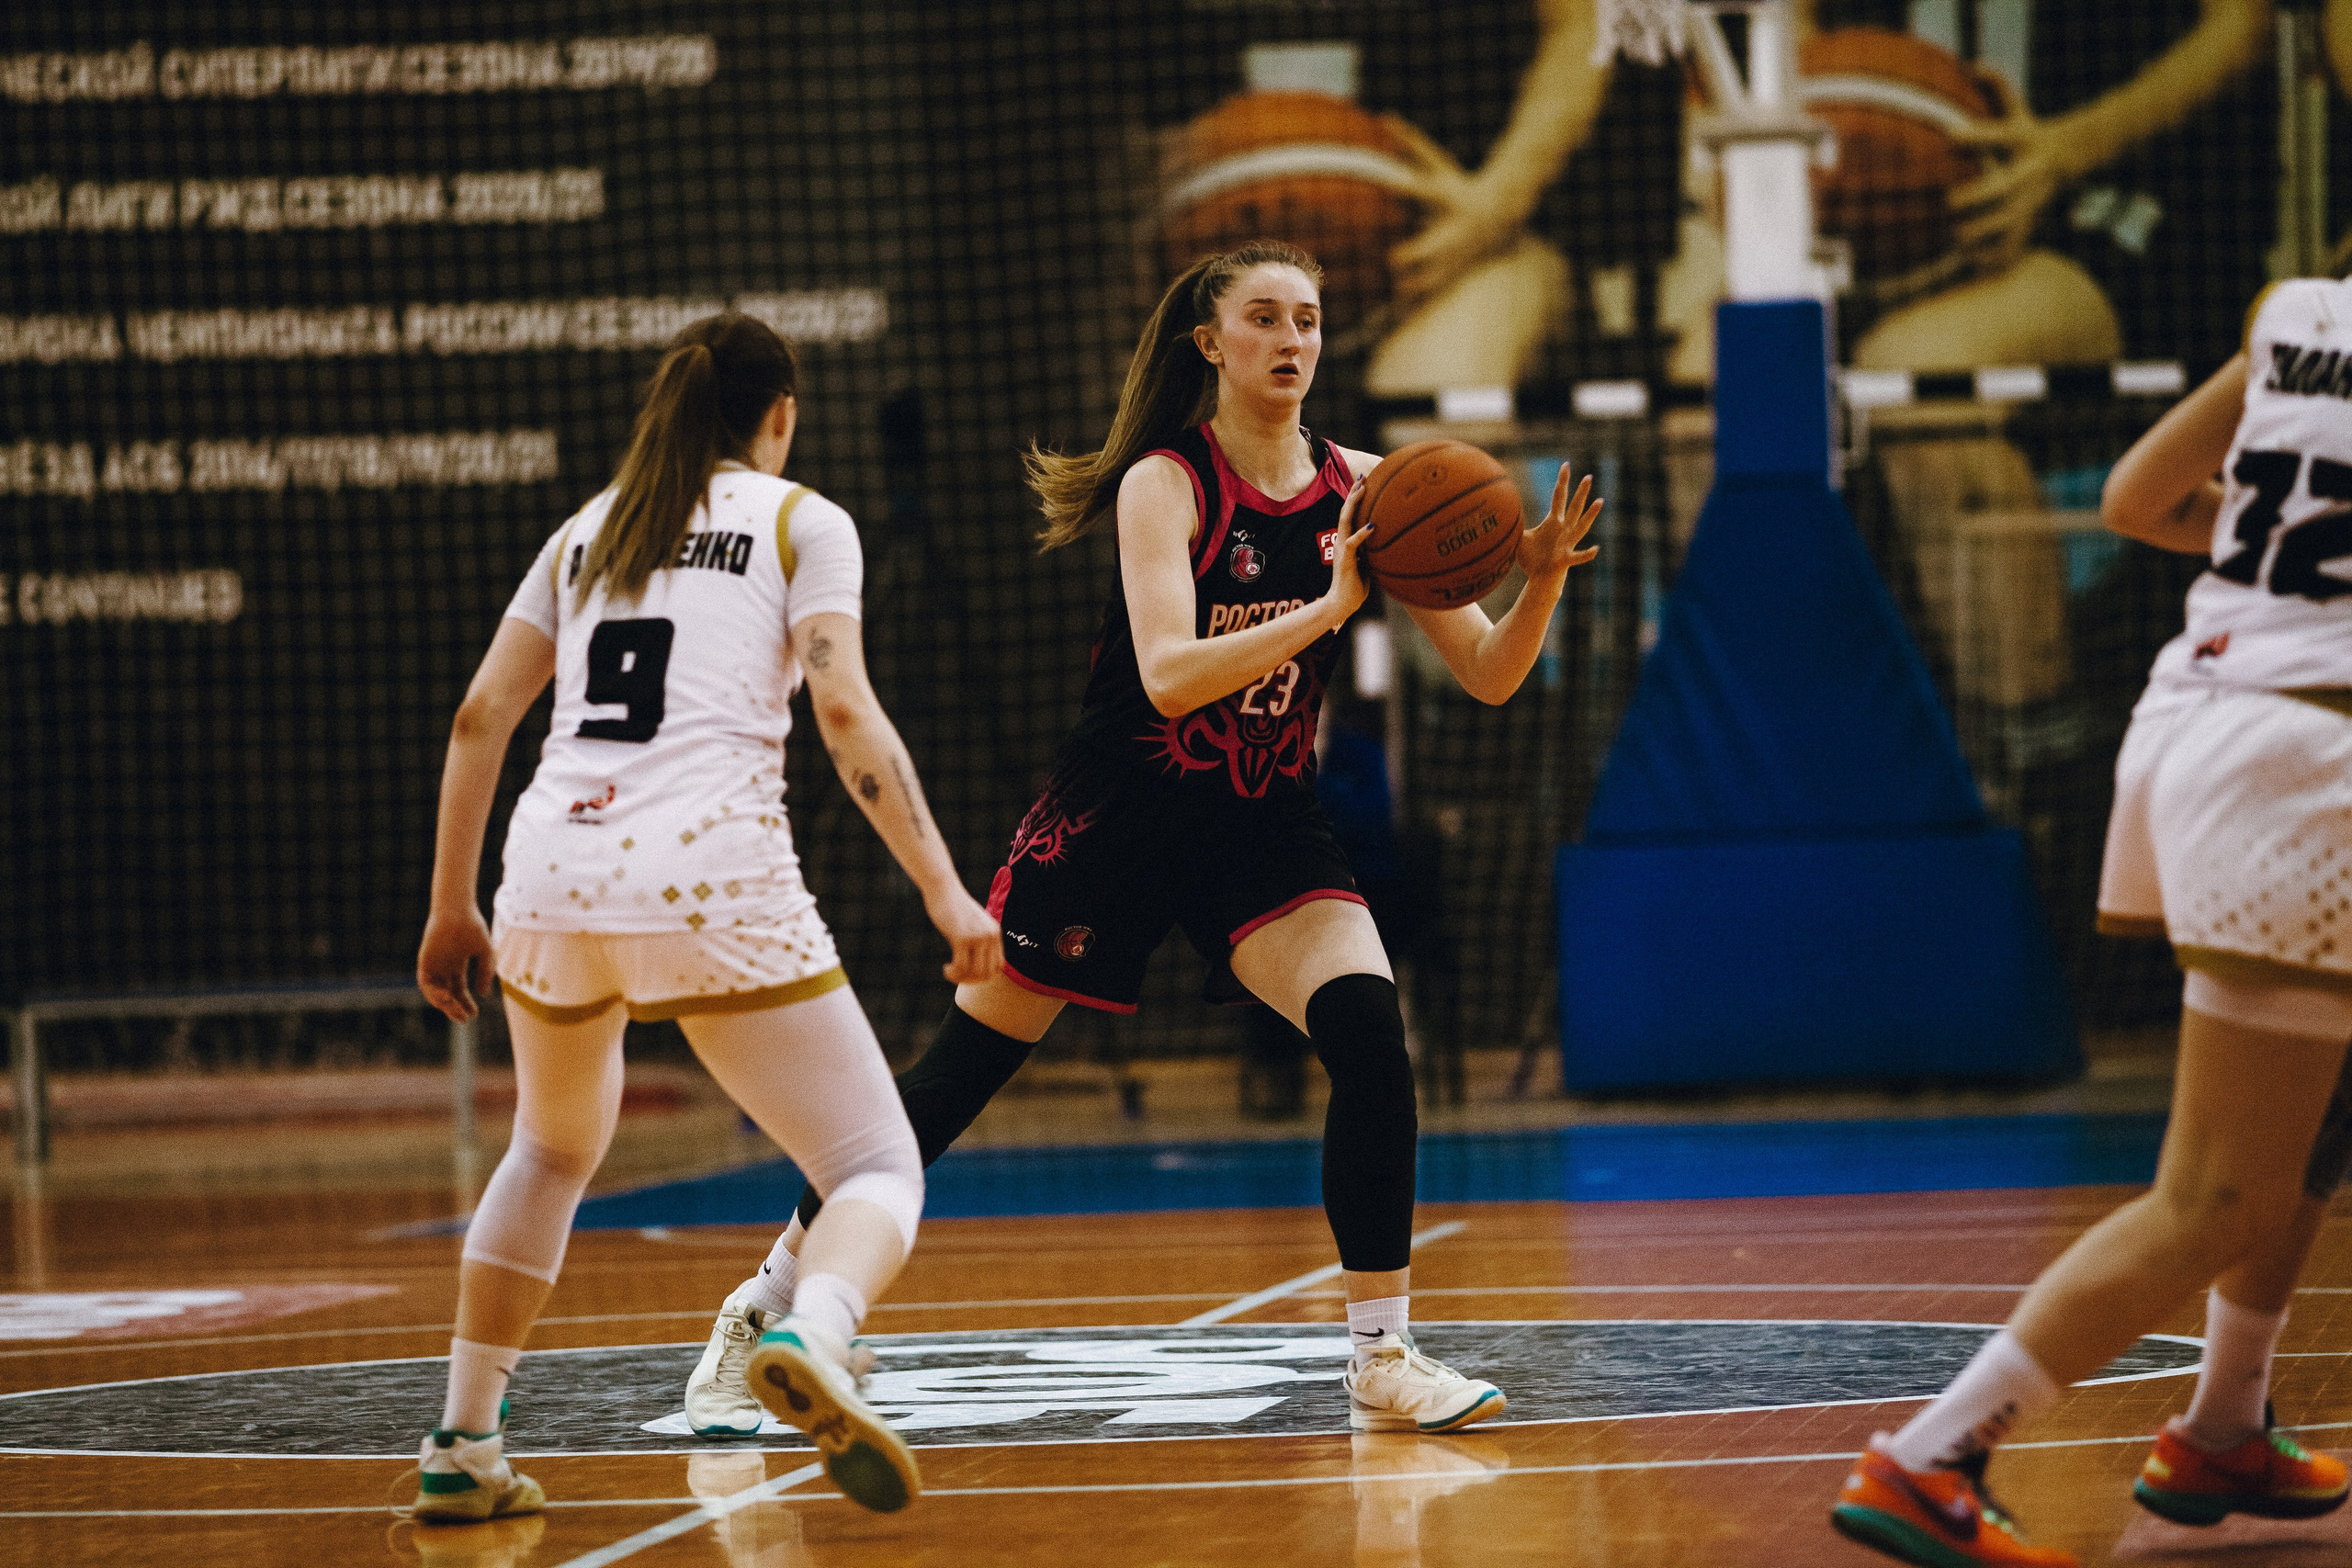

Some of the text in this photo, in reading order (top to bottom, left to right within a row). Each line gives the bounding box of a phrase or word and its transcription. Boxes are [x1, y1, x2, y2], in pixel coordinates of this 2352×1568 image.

[401, 42, 560, 95] СЕЗОНА
[66, 181, 175, 231] ЛИГИ
[286, 175, 445, 228] СЕЗОНА
[403, 302, 563, 354] РОССИИ
[18, 567, 243, 625] CONTINUED
[574, 617, 674, 744] 9
[1240, 660, 1300, 716] 23
